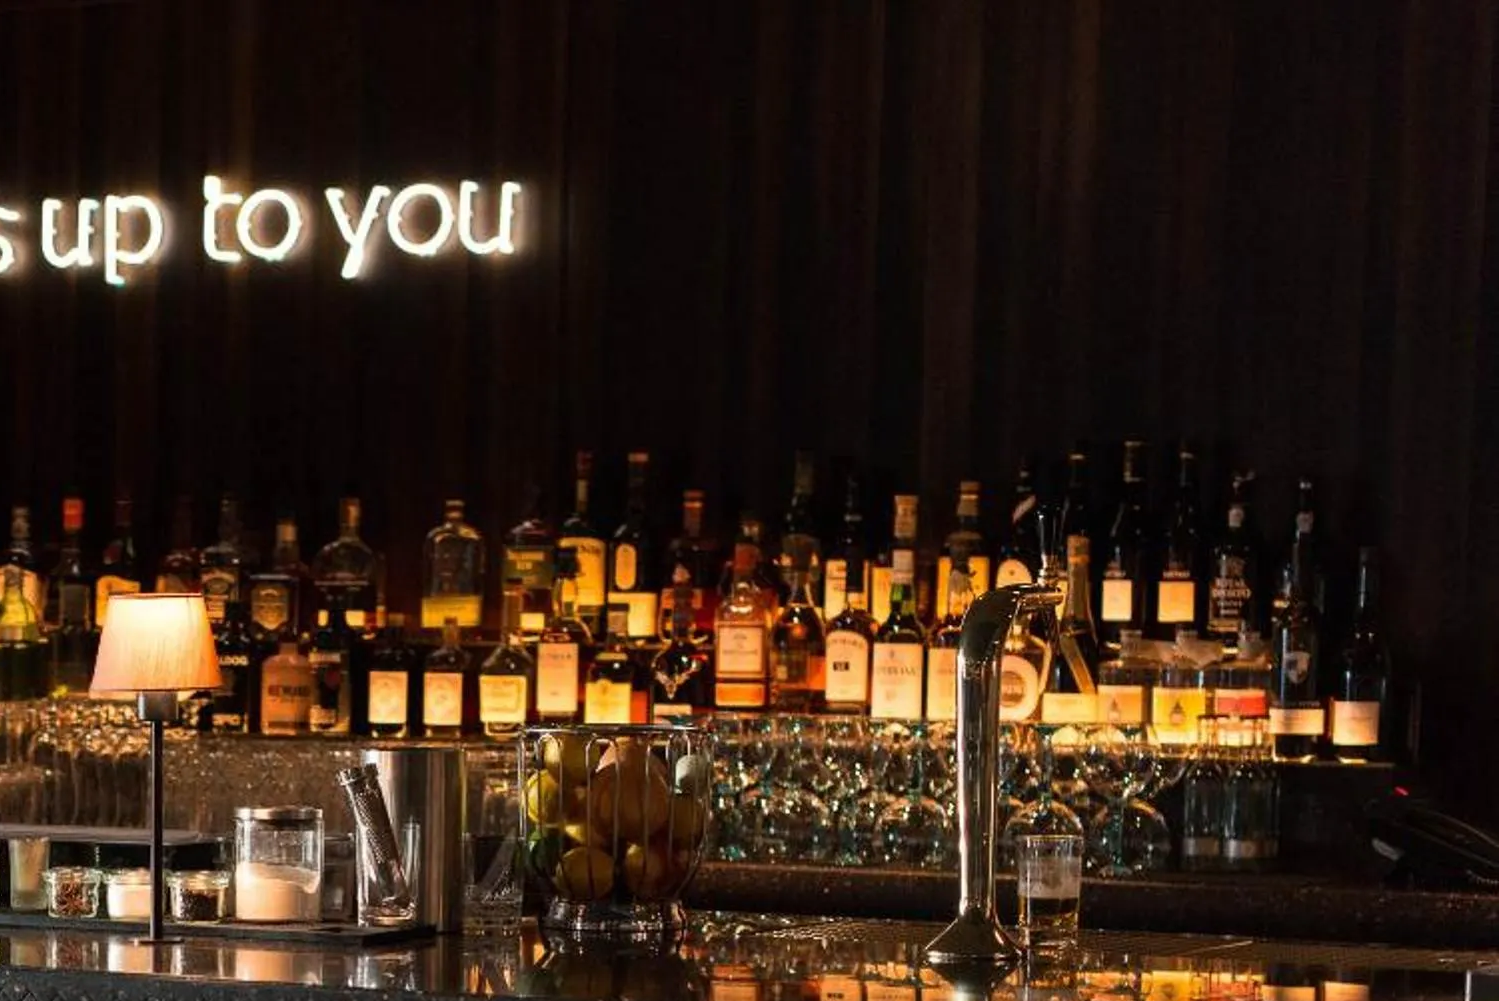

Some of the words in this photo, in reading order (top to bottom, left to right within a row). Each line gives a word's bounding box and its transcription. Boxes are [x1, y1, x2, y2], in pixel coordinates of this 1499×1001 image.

[42, 195, 162, 285] up
[203, 176, 301, 261] to
[325, 180, 521, 279] you
